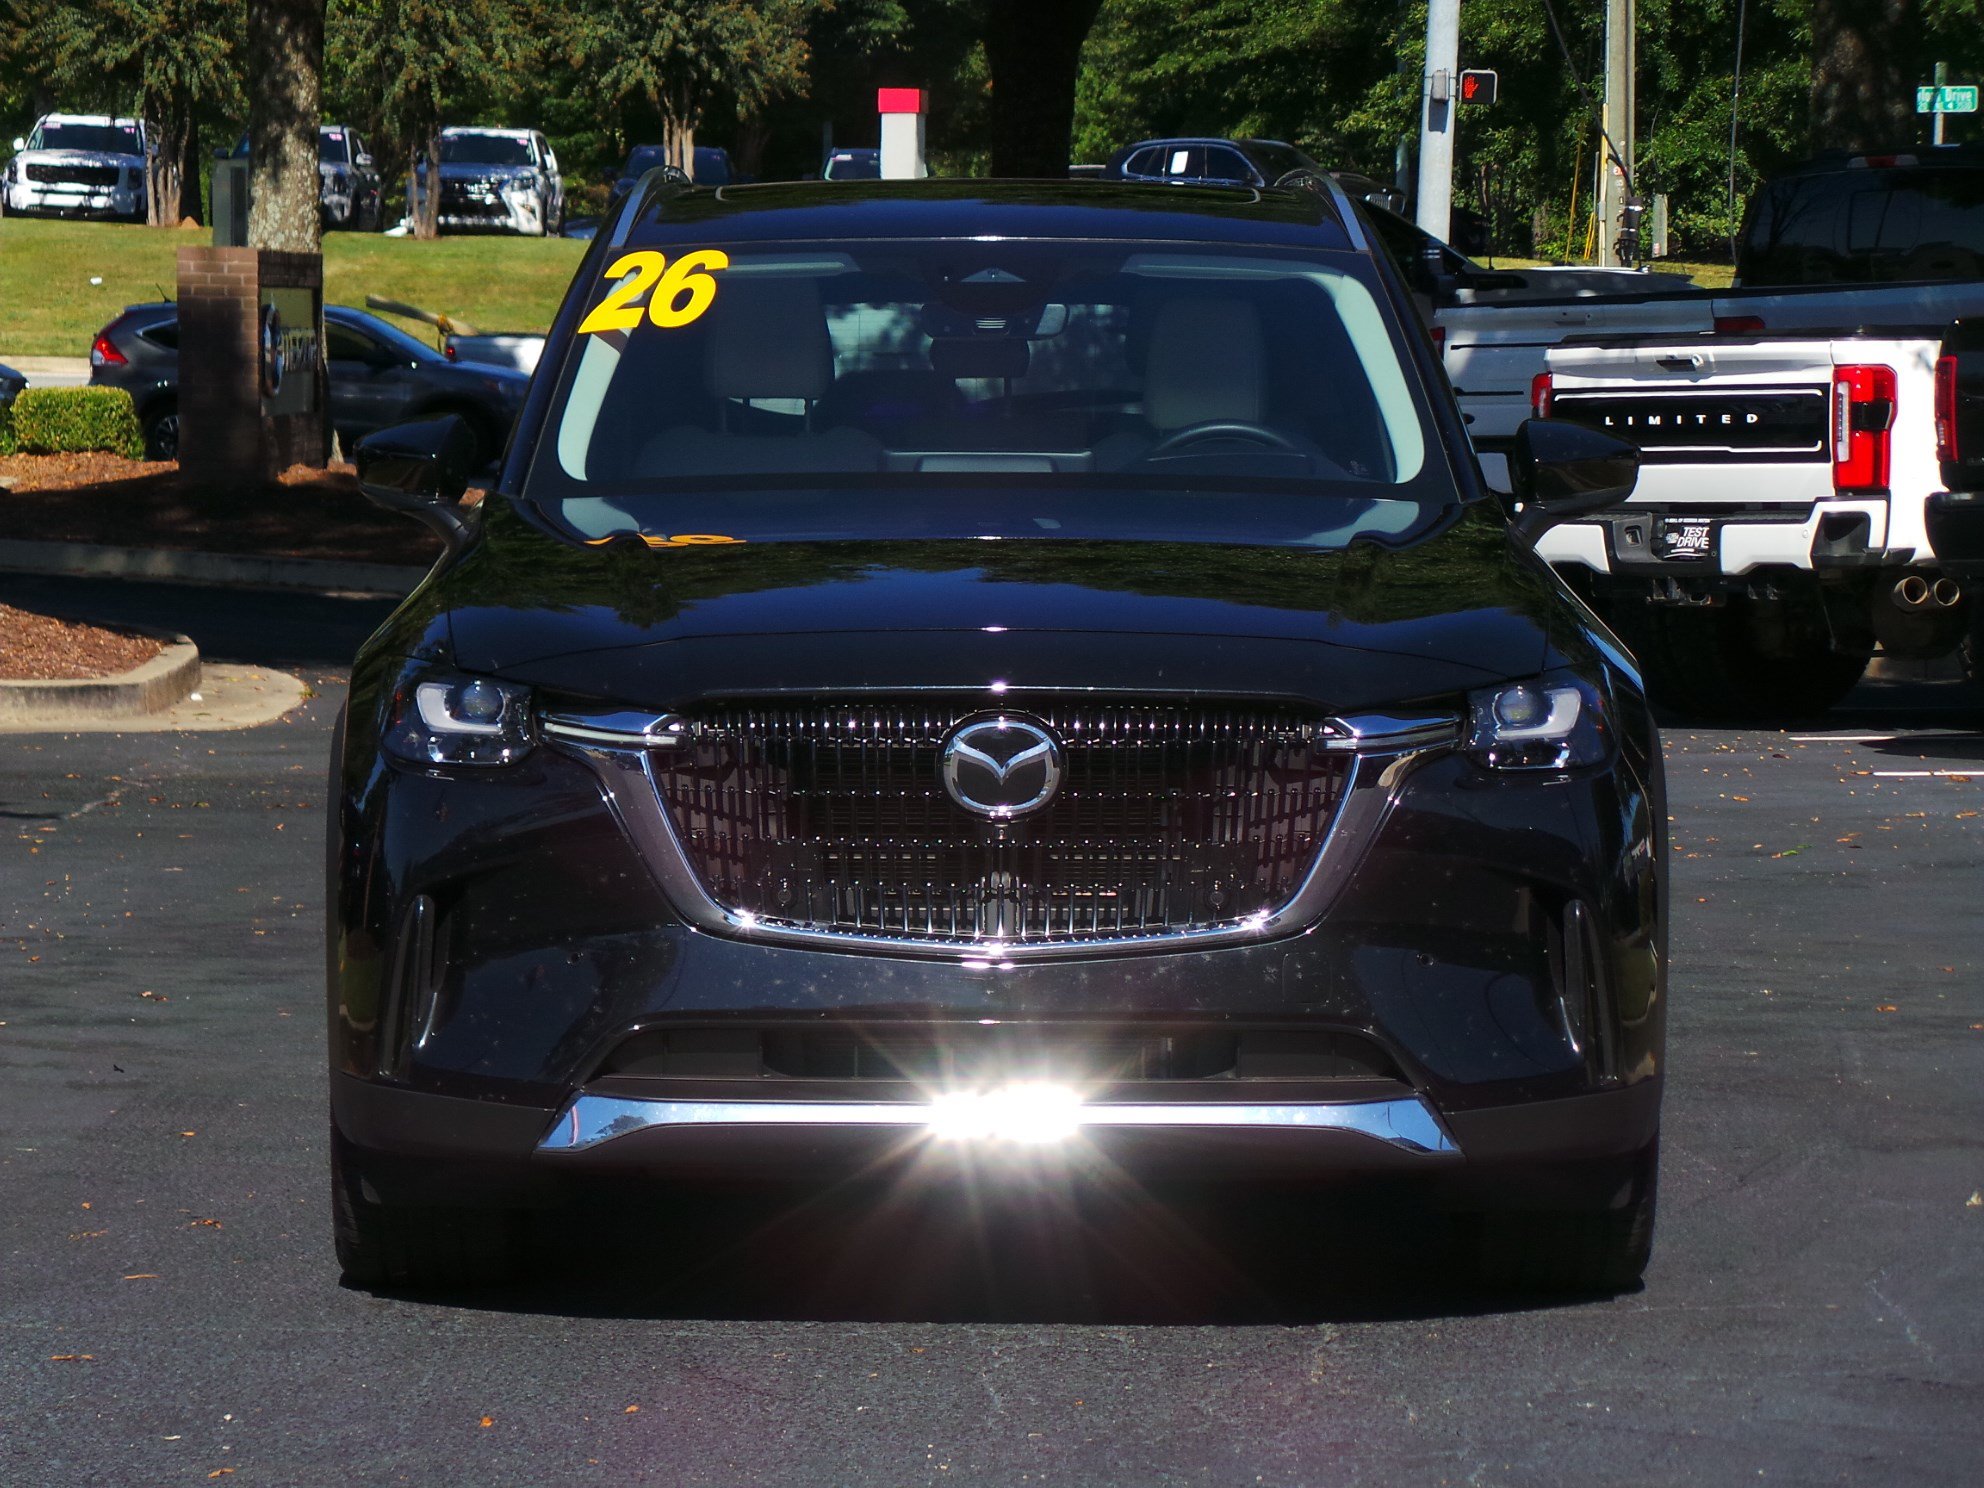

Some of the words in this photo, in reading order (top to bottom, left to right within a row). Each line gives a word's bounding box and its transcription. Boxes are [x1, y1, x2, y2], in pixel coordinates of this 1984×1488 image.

[577, 249, 730, 334] 26
[1605, 413, 1759, 426] LIMITED
[1683, 526, 1710, 537] TEST
[1677, 536, 1710, 549] DRIVE
